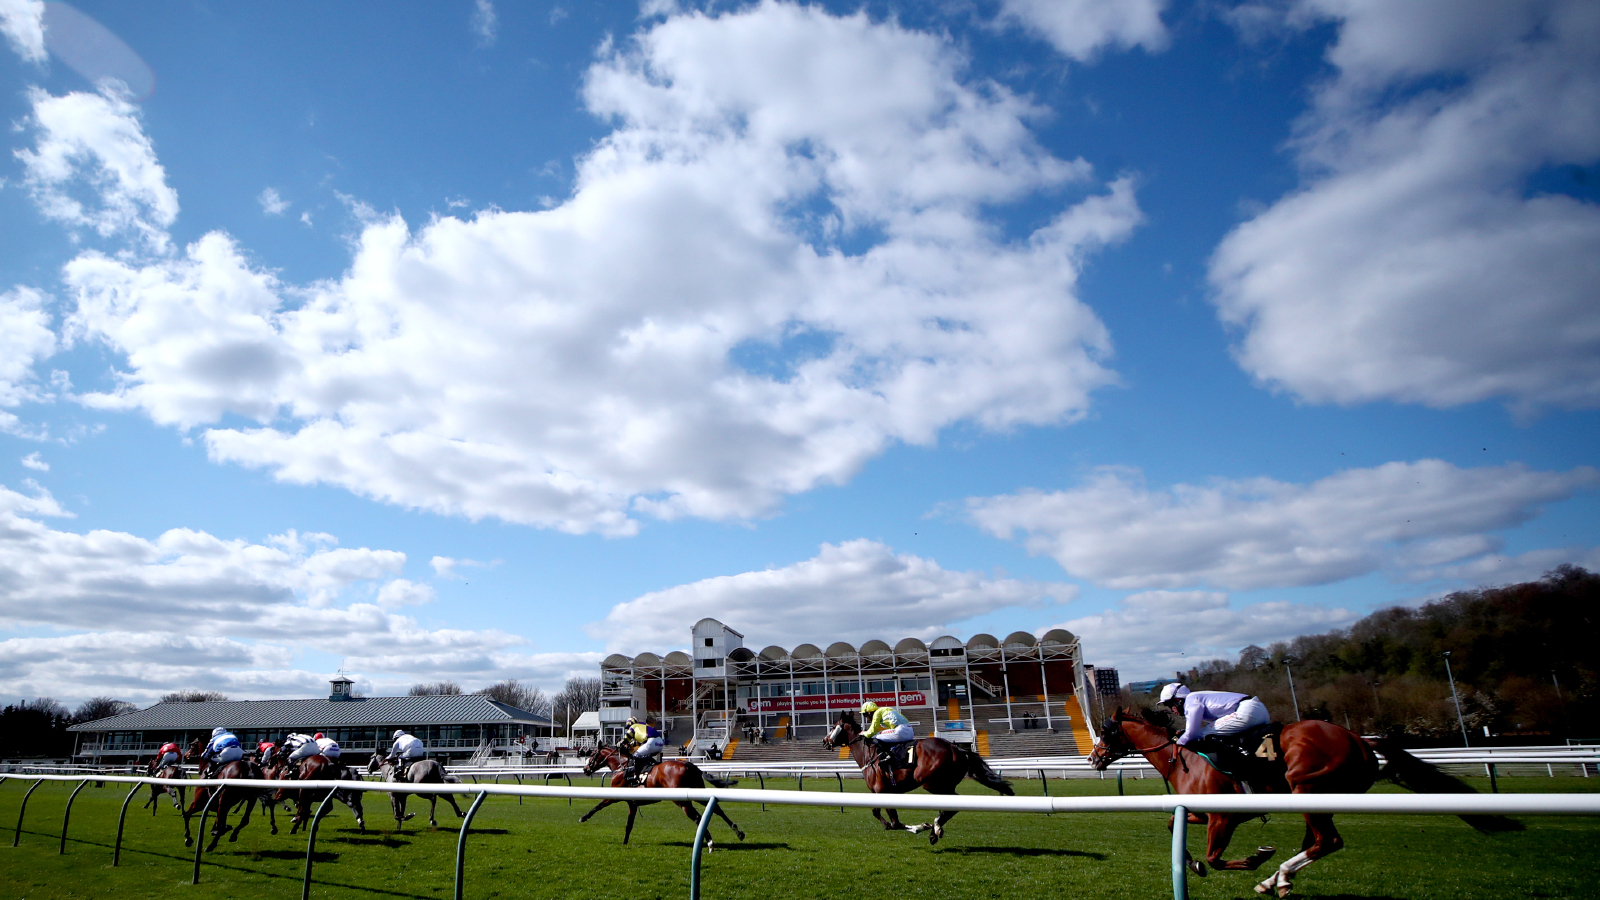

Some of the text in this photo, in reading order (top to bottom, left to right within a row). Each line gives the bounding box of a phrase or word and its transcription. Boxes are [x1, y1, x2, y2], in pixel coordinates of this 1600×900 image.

[899, 694, 922, 703] gem
[907, 747, 914, 763] 1
[1255, 738, 1277, 761] 4
